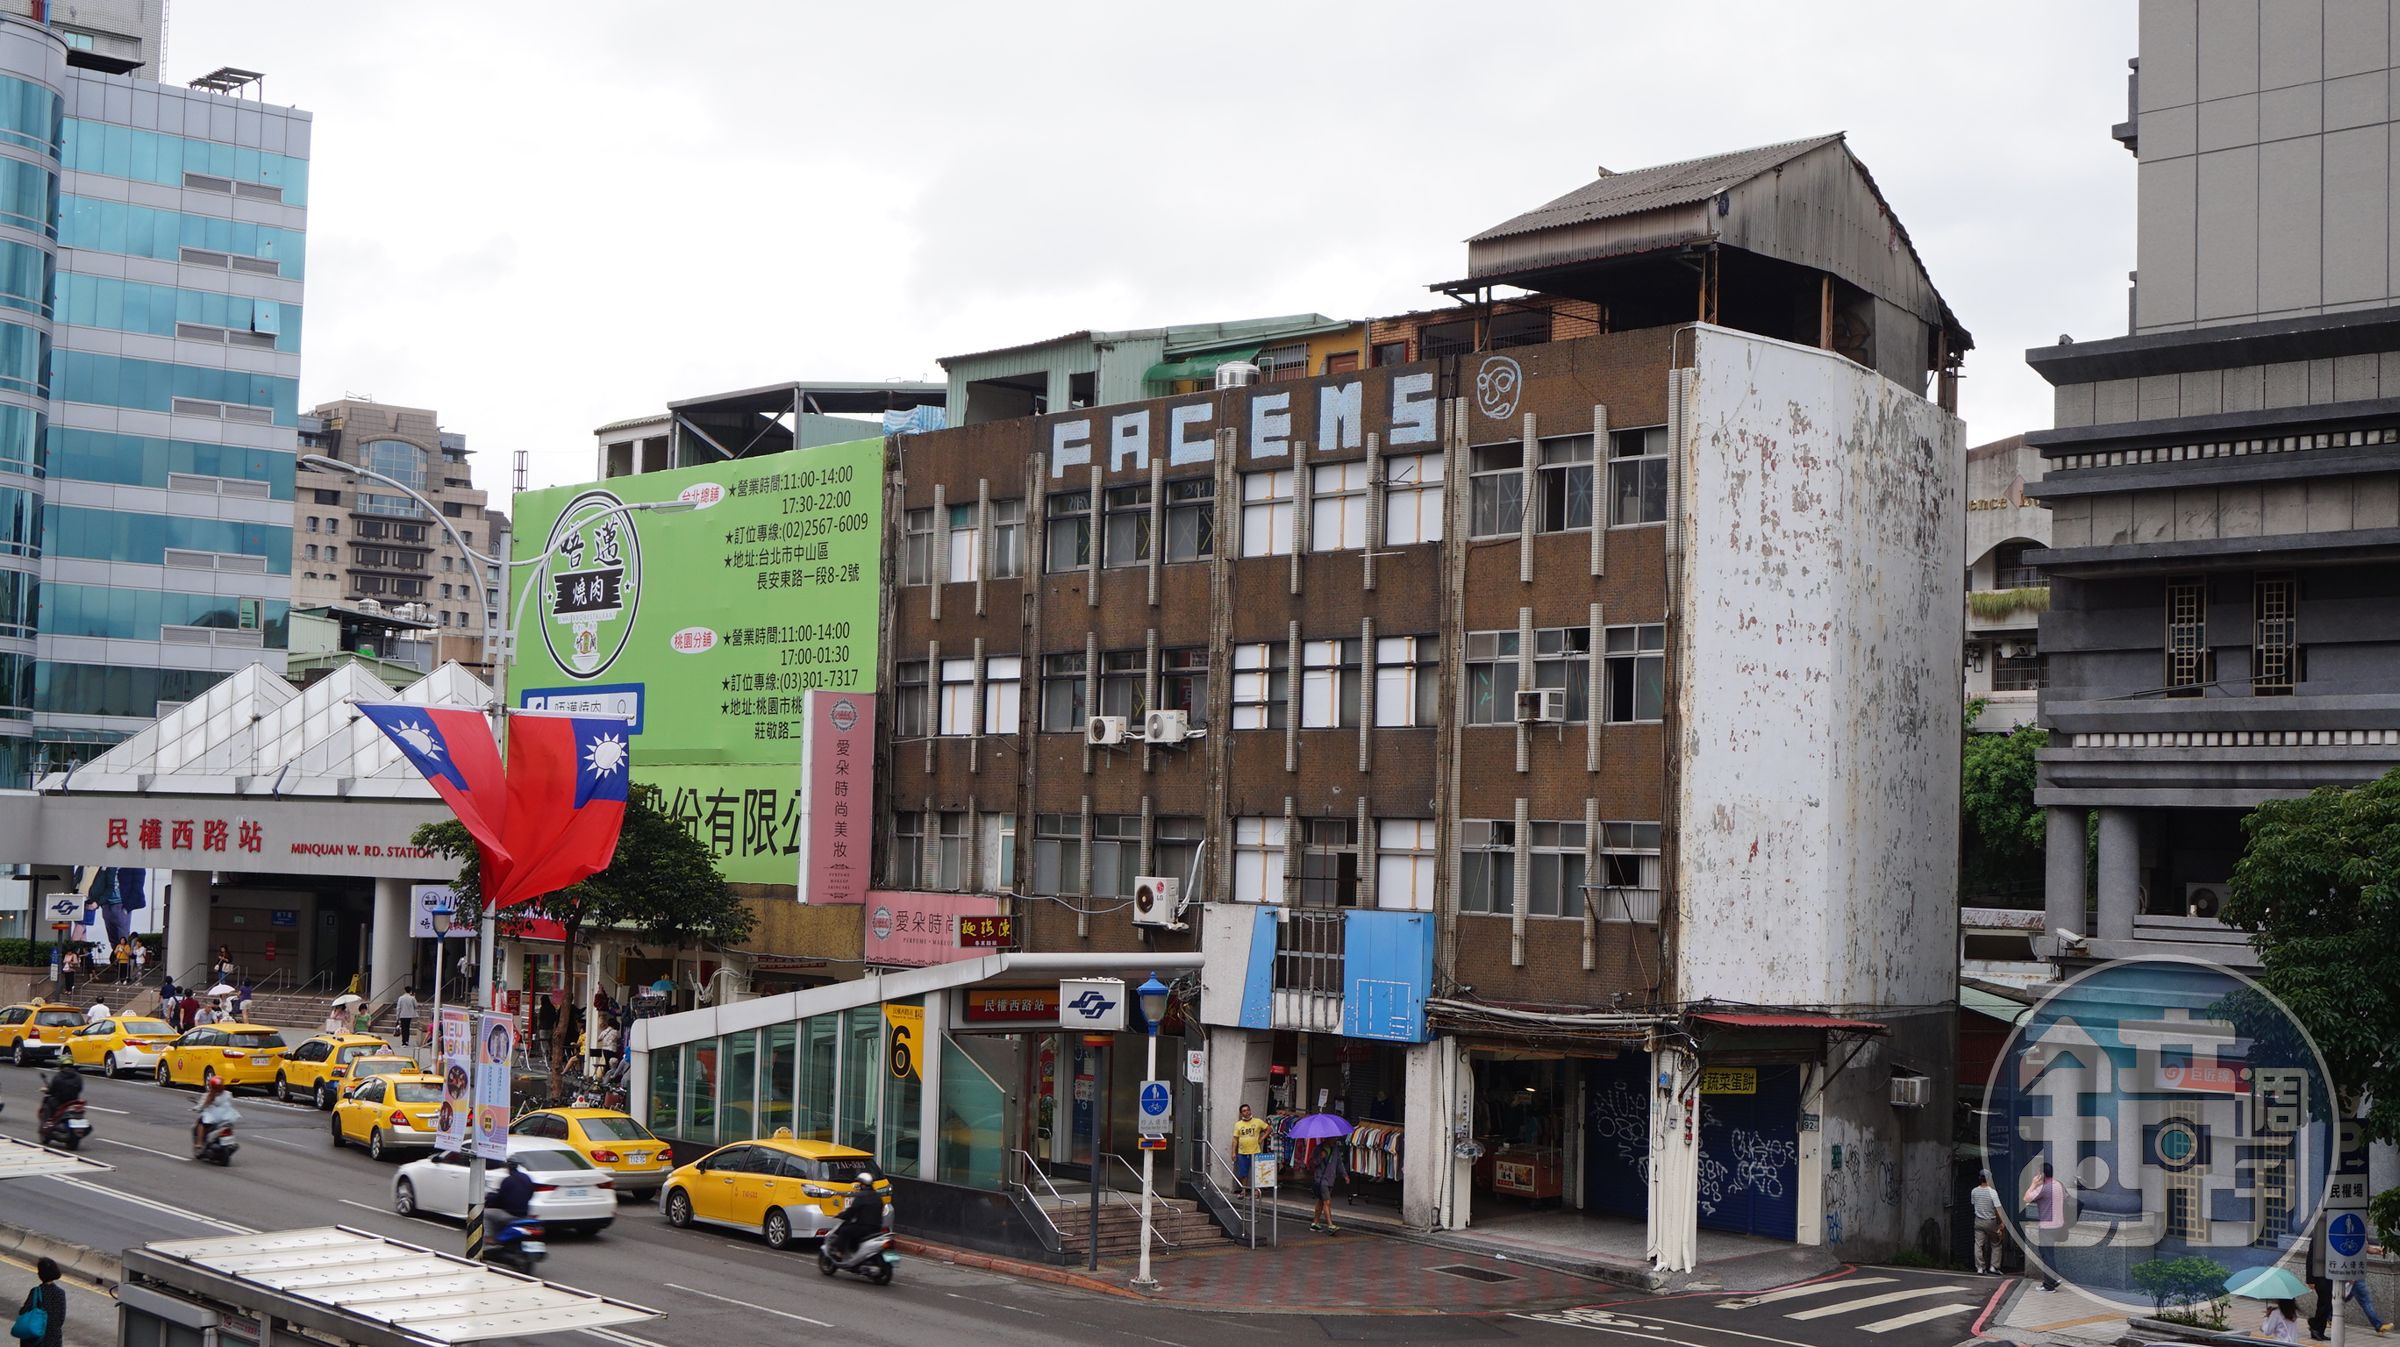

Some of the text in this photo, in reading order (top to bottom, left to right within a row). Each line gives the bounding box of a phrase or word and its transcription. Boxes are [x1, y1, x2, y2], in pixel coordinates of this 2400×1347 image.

[782, 490, 851, 515] 17:30-22:00
[734, 512, 869, 545] 訂位專線:(02)2567-6009
[733, 541, 829, 569] 地址:台北市中山區
[757, 563, 860, 590] 長安東路一段8-2號
[572, 575, 604, 607] 燒肉
[732, 621, 850, 647] 營業時間:11:00-14:00
[780, 645, 850, 666] 17:00-01:30
[731, 669, 859, 694] 訂位專線:(03)301-7317
[833, 739, 851, 858] 愛朵時尚美妝
[106, 817, 264, 854] 民權西路站
[291, 843, 344, 857] MINQUAN
[347, 845, 361, 856] W.
[364, 846, 384, 857] RD.
[984, 999, 1045, 1012] 民權西路站
[889, 1024, 912, 1079] 6
